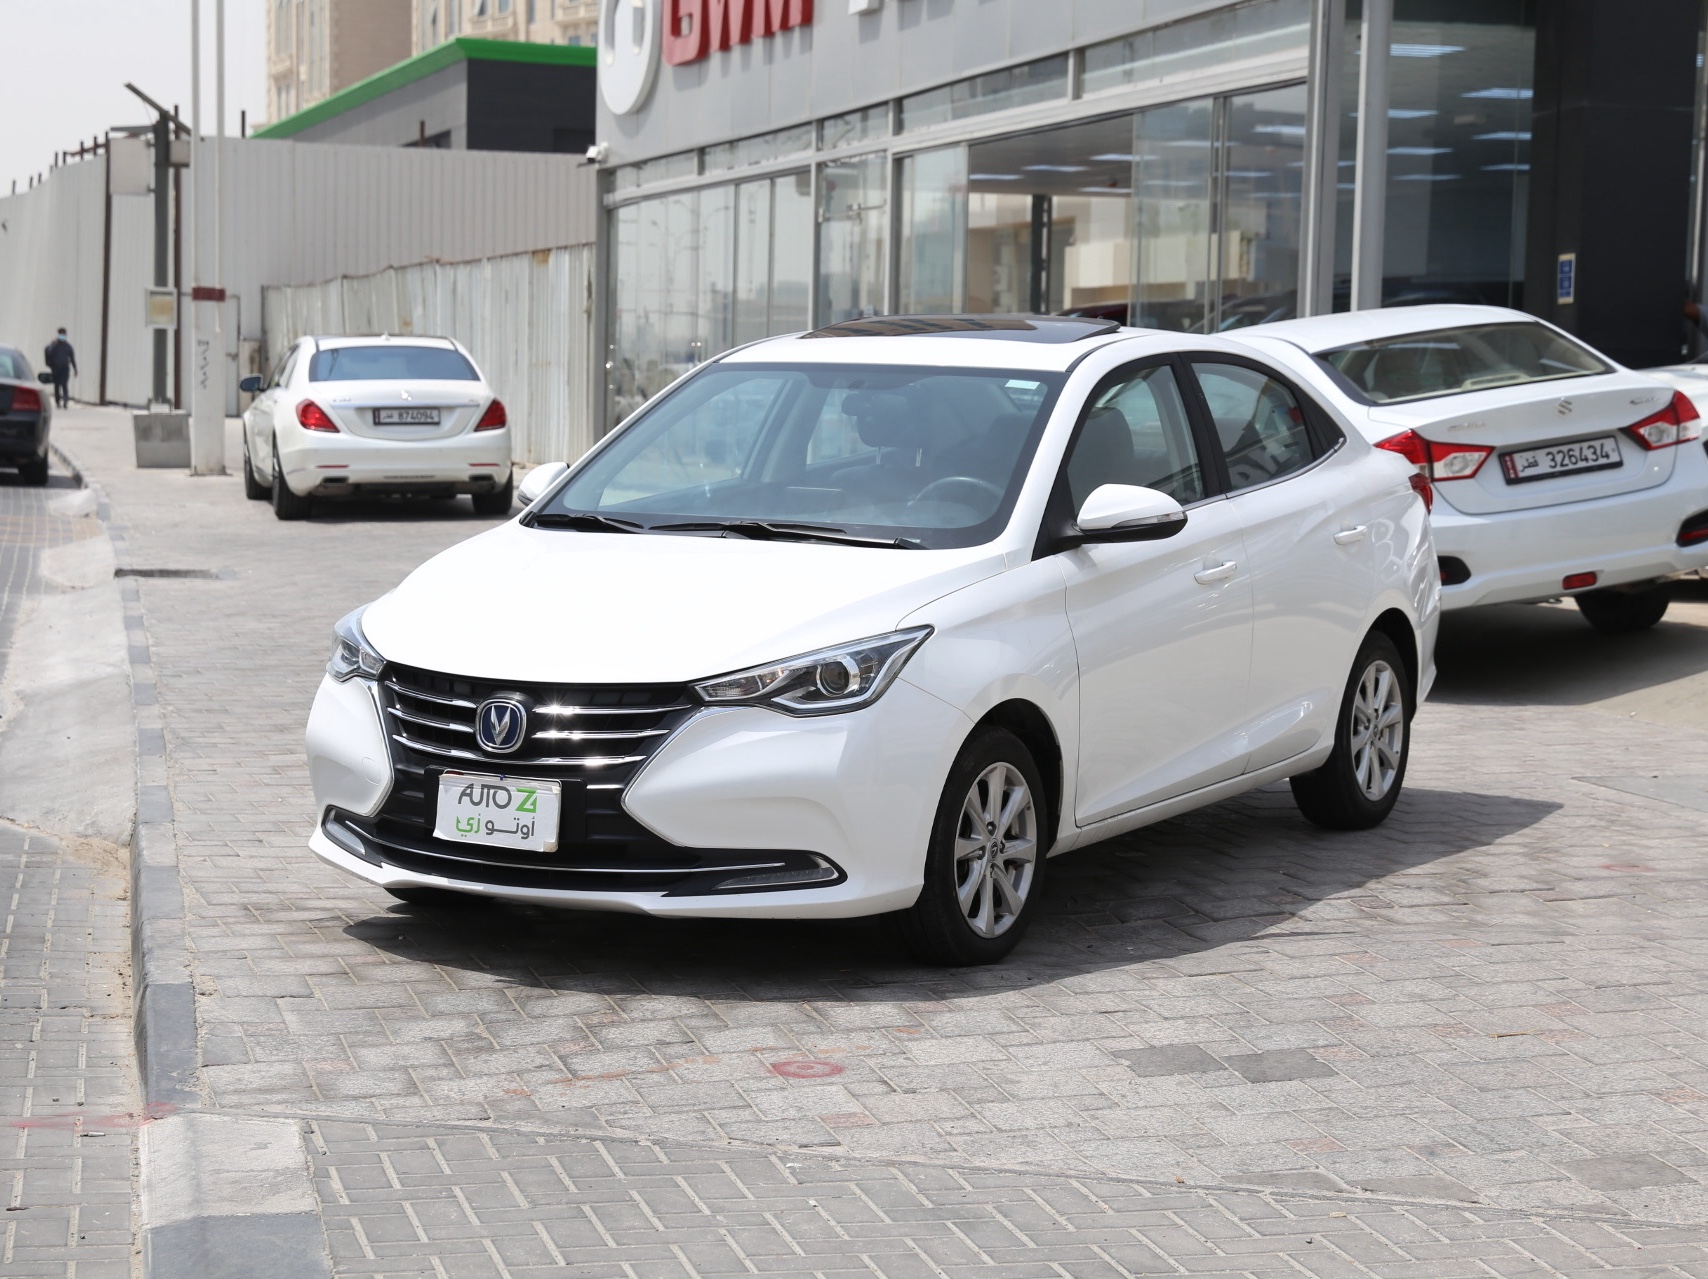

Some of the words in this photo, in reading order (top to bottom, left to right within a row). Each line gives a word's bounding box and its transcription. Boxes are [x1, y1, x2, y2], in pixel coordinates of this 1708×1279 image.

[1545, 442, 1610, 469] 326434
[457, 783, 512, 809] AUTO
[515, 787, 538, 813] Z
